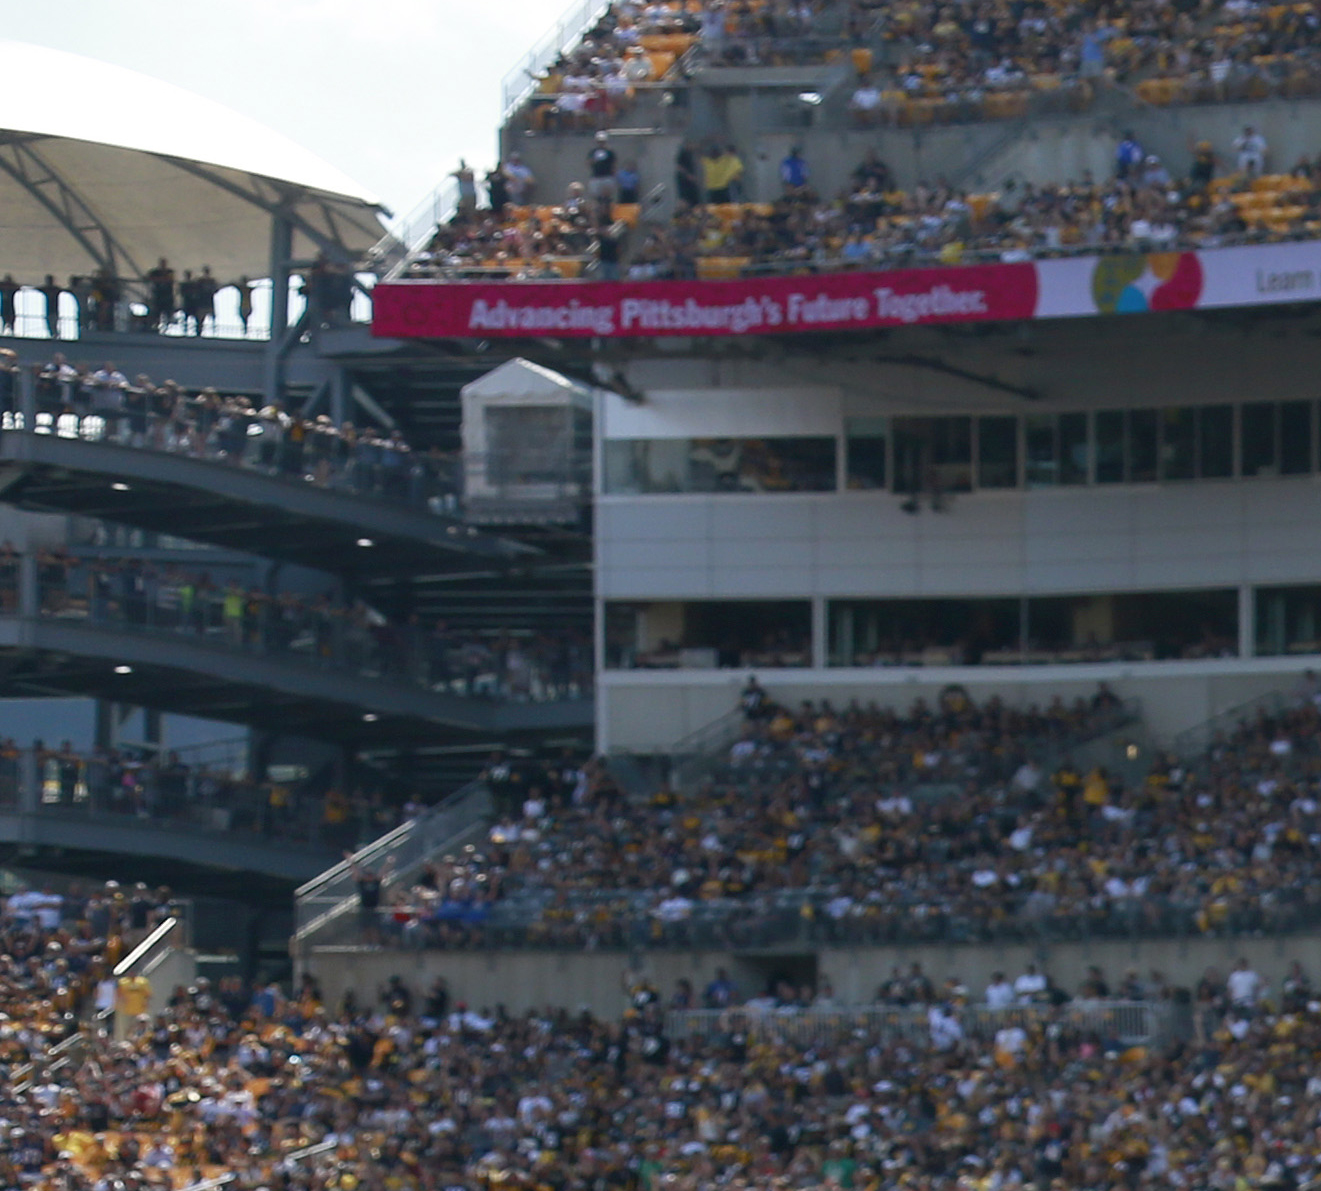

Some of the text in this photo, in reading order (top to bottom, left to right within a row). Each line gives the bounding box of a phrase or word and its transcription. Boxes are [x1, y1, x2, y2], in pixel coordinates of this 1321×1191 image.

[1256, 268, 1314, 293] Learn
[467, 299, 616, 334] Advancing
[620, 295, 783, 334] Pittsburgh's
[787, 292, 870, 325] Future
